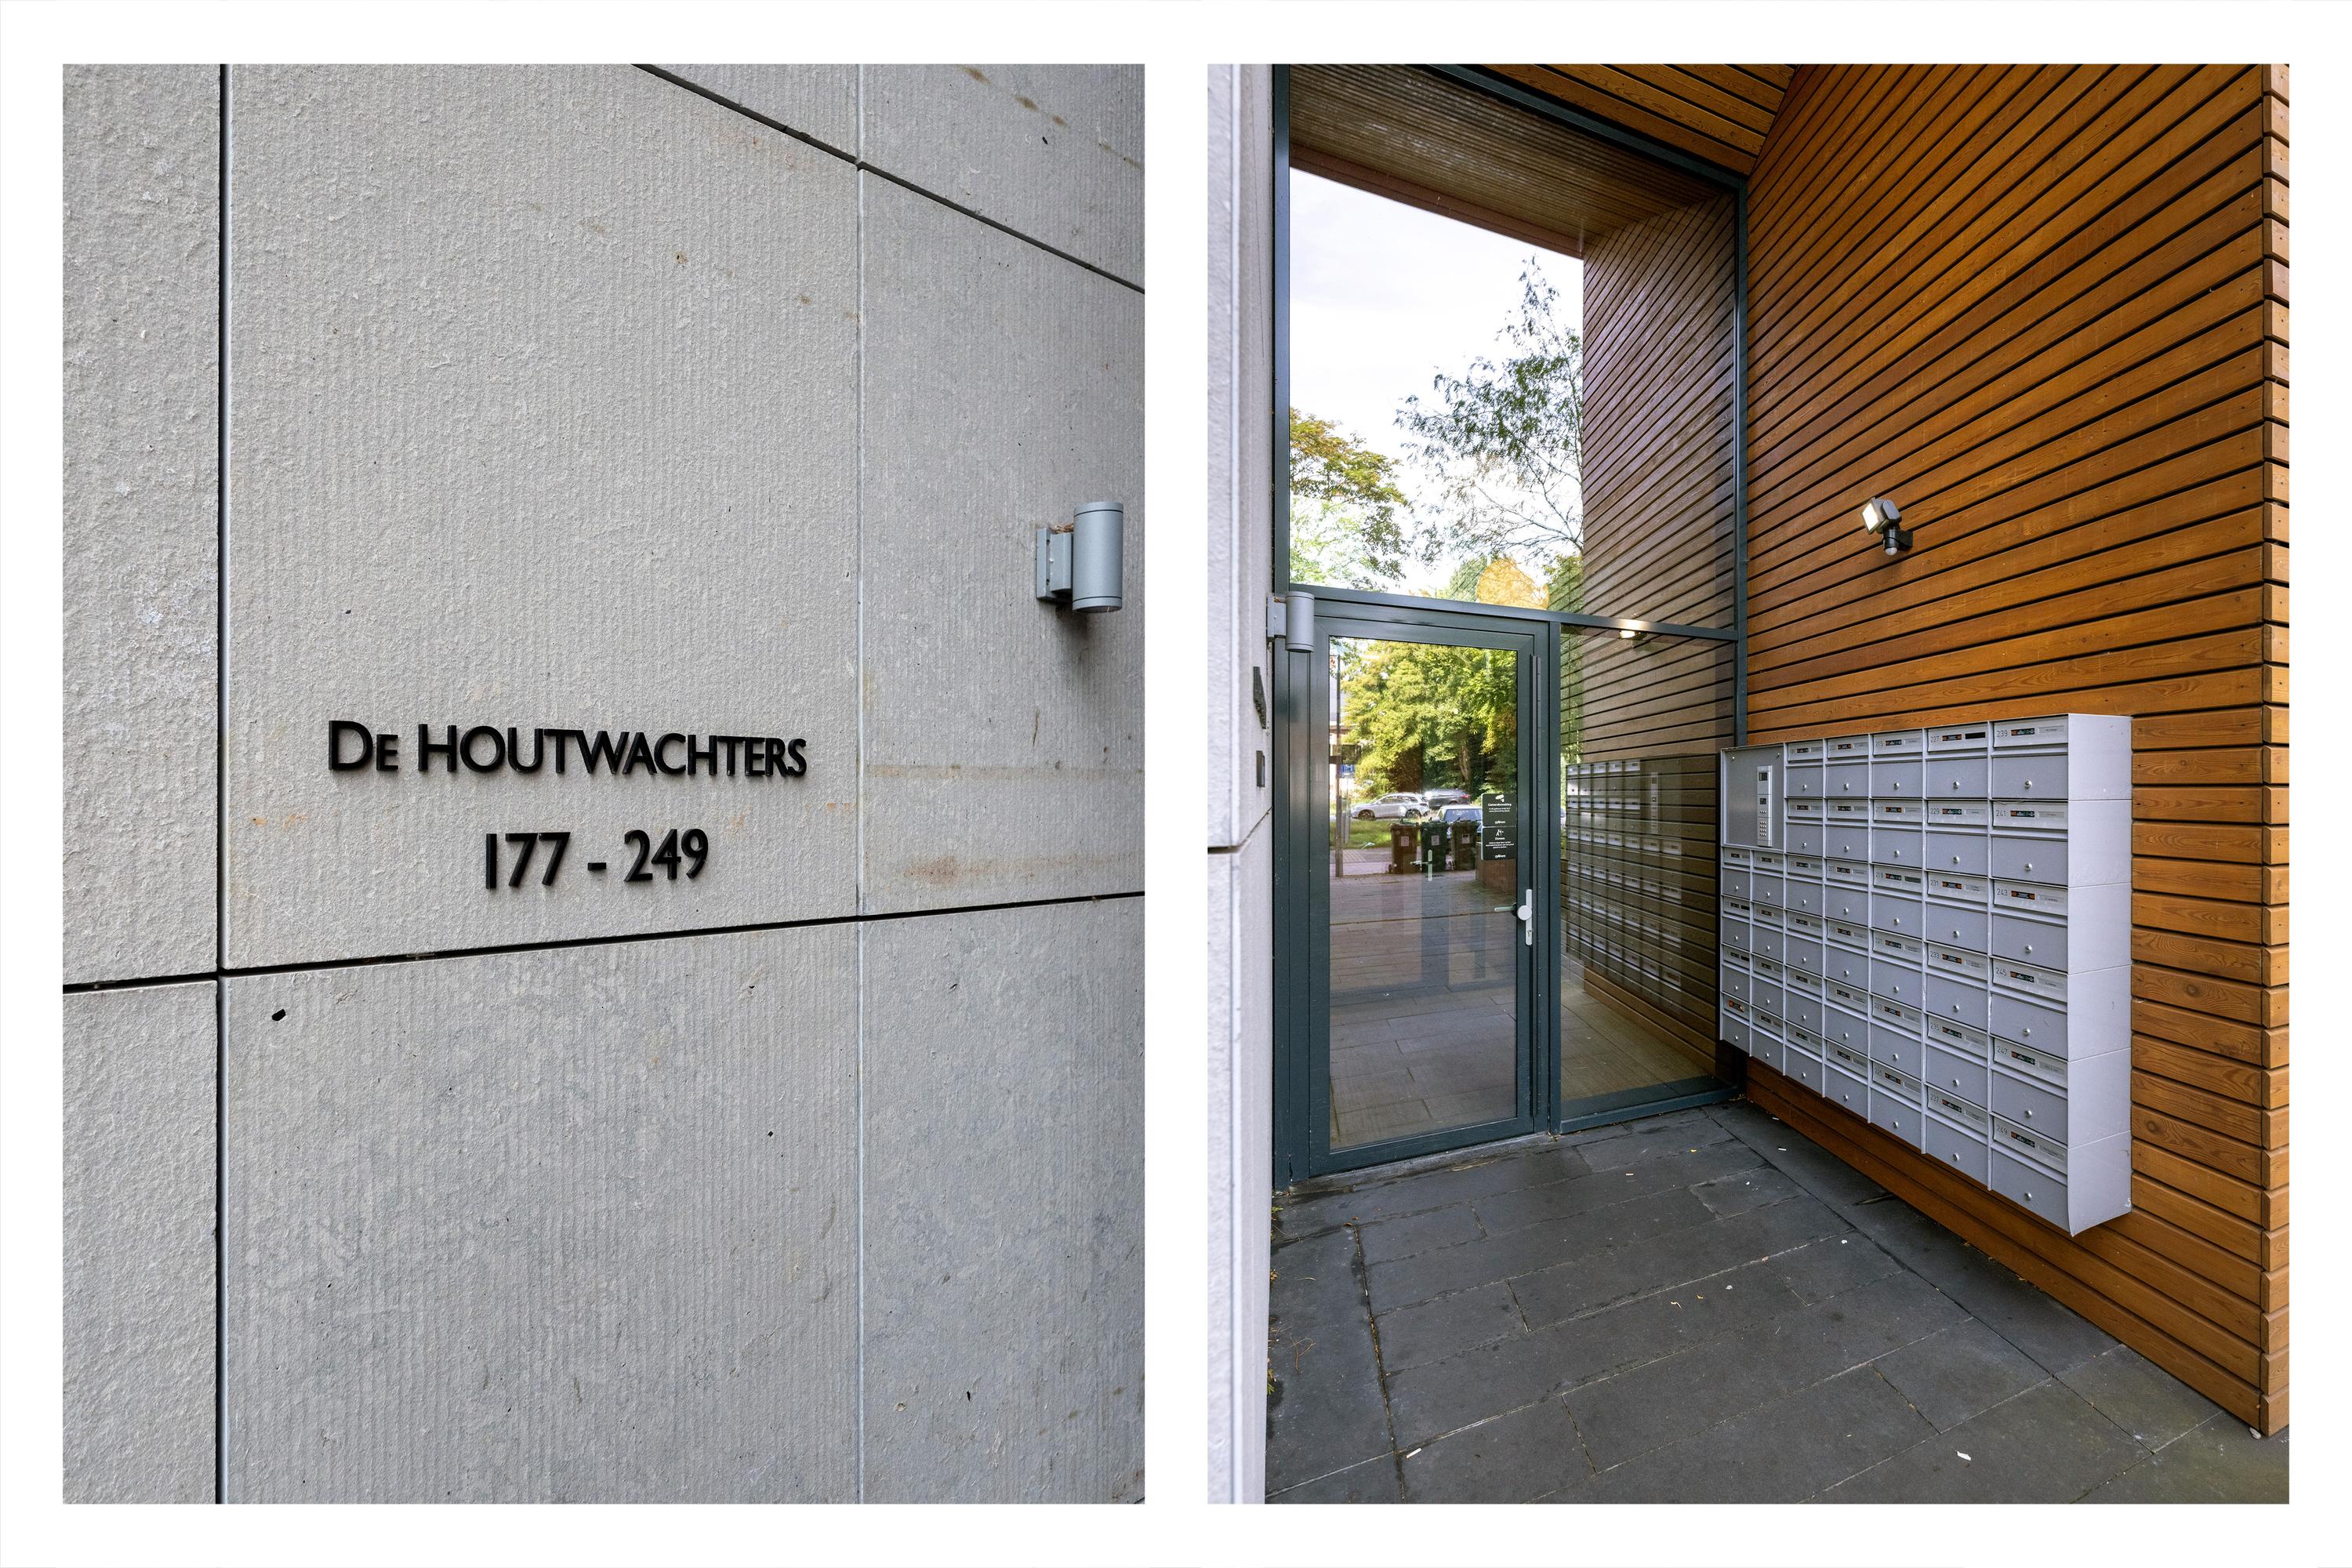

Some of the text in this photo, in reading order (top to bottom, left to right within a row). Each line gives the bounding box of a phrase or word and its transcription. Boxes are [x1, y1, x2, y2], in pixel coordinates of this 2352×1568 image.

[417, 723, 808, 777] HOUTWACHTERS
[485, 828, 710, 891] 177 - 249
[1930, 950, 1940, 959] 233
[1996, 967, 2007, 976] 245
[1997, 1046, 2008, 1055] 247
[1996, 1124, 2008, 1135] 249
